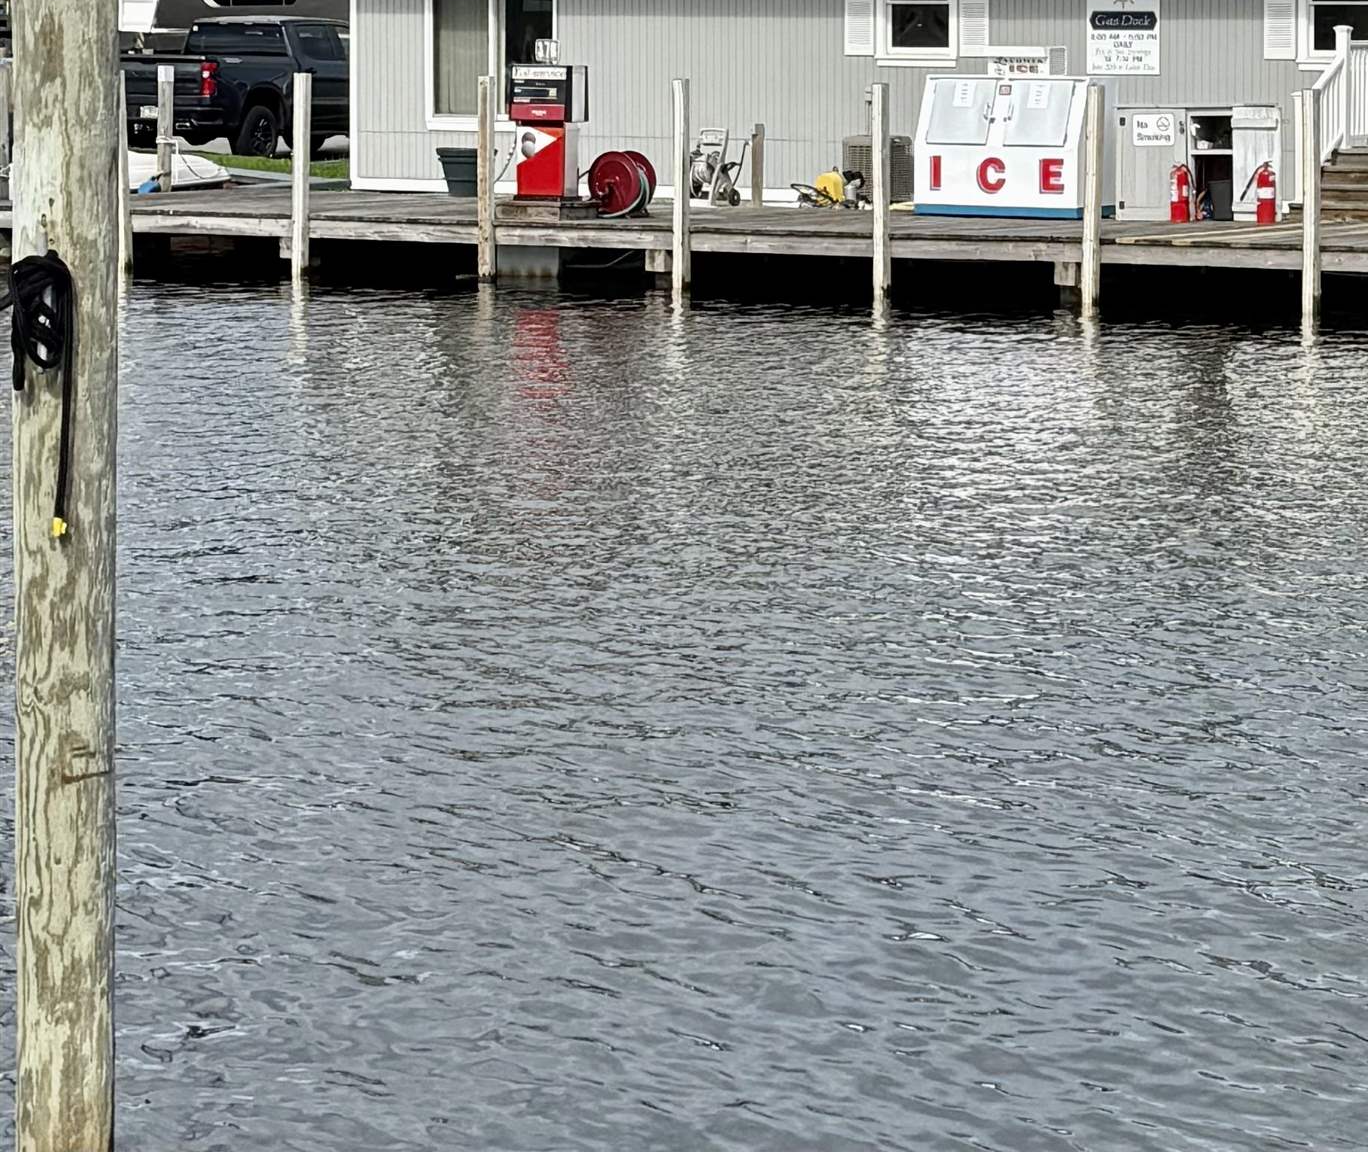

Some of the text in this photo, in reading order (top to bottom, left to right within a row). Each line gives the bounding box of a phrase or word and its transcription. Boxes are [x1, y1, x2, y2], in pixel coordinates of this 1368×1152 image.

[1121, 14, 1151, 26] Dock
[1008, 64, 1039, 74] ICE
[930, 155, 1064, 194] ICE
